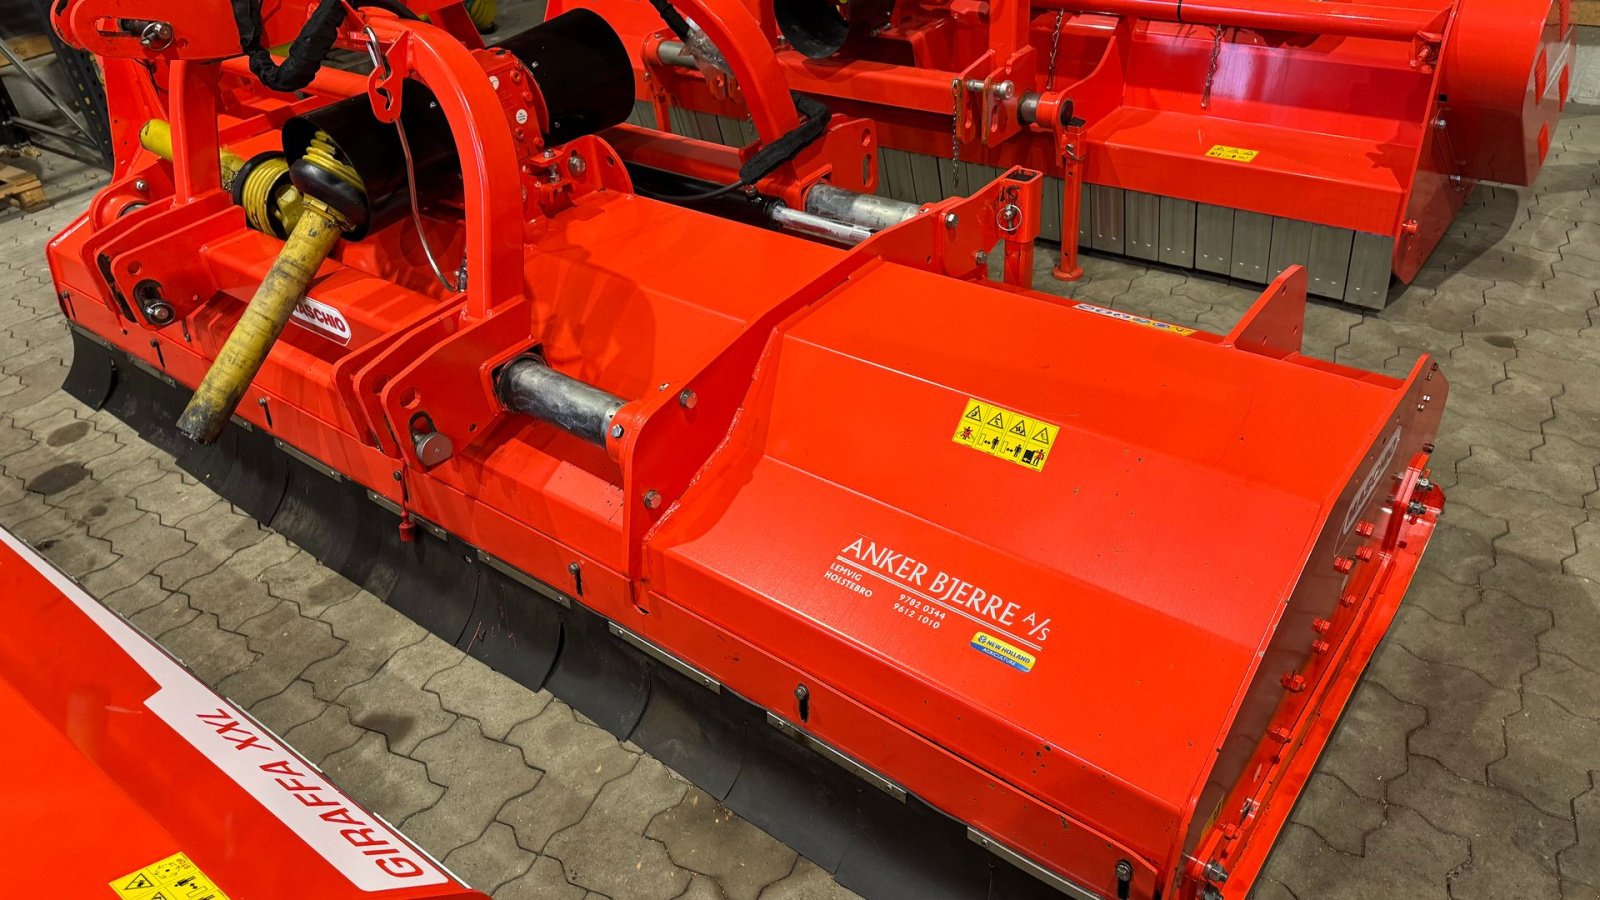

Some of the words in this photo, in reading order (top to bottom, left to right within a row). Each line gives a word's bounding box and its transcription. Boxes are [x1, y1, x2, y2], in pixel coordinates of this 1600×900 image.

[824, 571, 873, 597] HOLSTEBRO
[830, 562, 862, 581] LEMVIG
[842, 537, 928, 586] ANKER
[928, 571, 1021, 626] BJERRE
[1022, 612, 1051, 641] A/S
[893, 602, 915, 618] 9612
[918, 614, 940, 629] 1010
[899, 594, 921, 609] 9782
[923, 605, 946, 620] 0344
[986, 640, 1001, 649] NEW
[1002, 647, 1030, 663] HOLLAND
[196, 708, 274, 751] XXL
[259, 760, 424, 878] GIRAFFA
